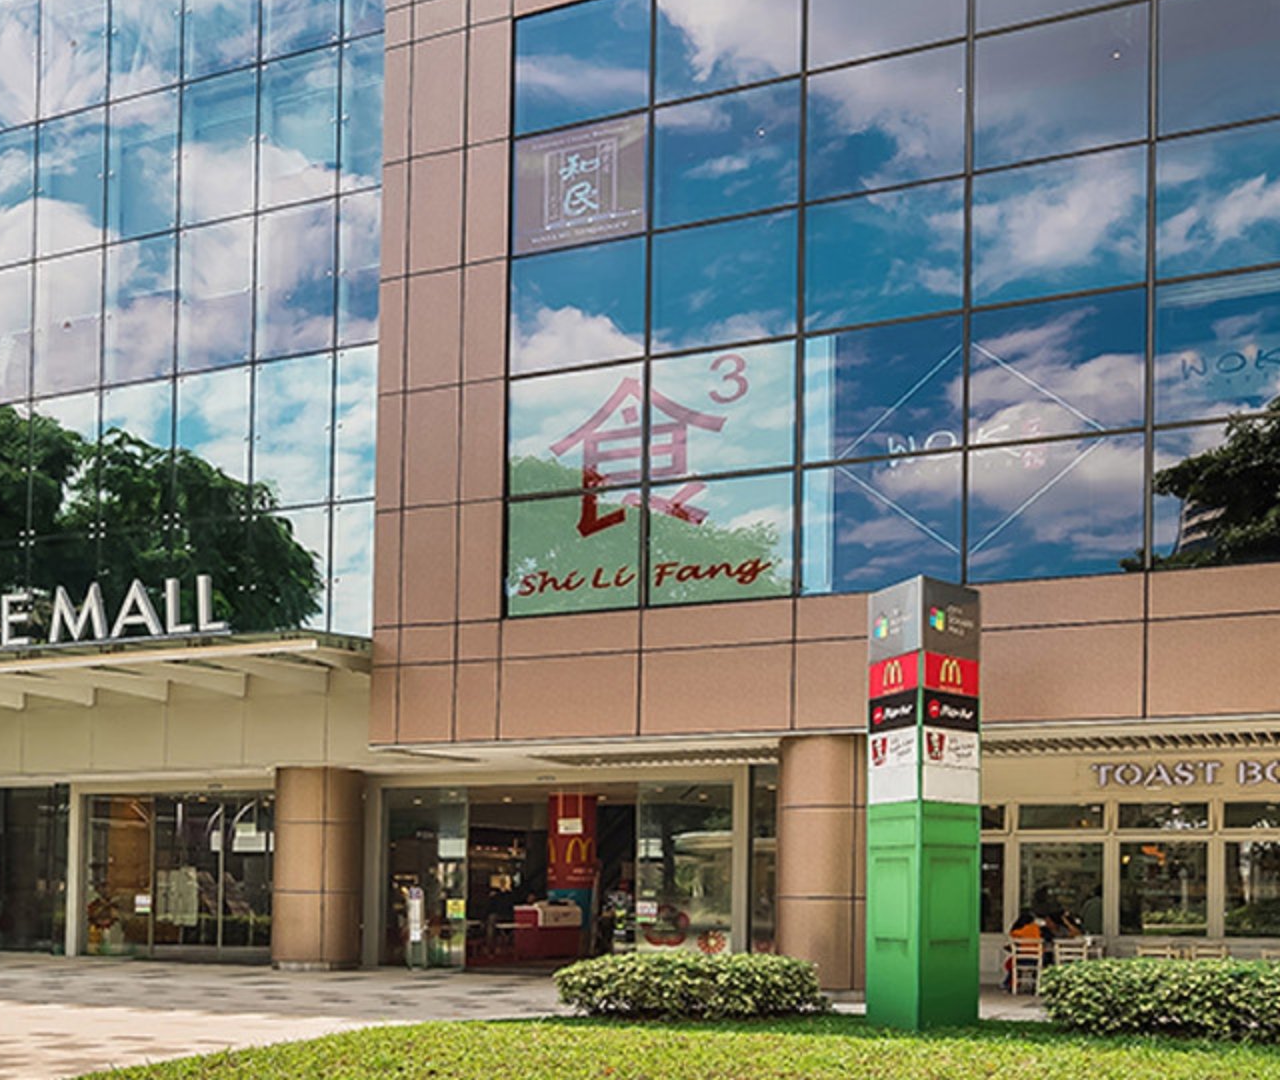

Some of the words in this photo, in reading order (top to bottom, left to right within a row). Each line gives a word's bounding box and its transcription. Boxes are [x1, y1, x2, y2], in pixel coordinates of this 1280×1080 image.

[549, 376, 728, 538] 食
[887, 424, 1020, 468] WOK
[517, 570, 585, 597] Shi
[591, 566, 636, 589] Li
[654, 557, 772, 588] Fang
[49, 574, 228, 643] MALL
[1091, 760, 1224, 787] TOAST
